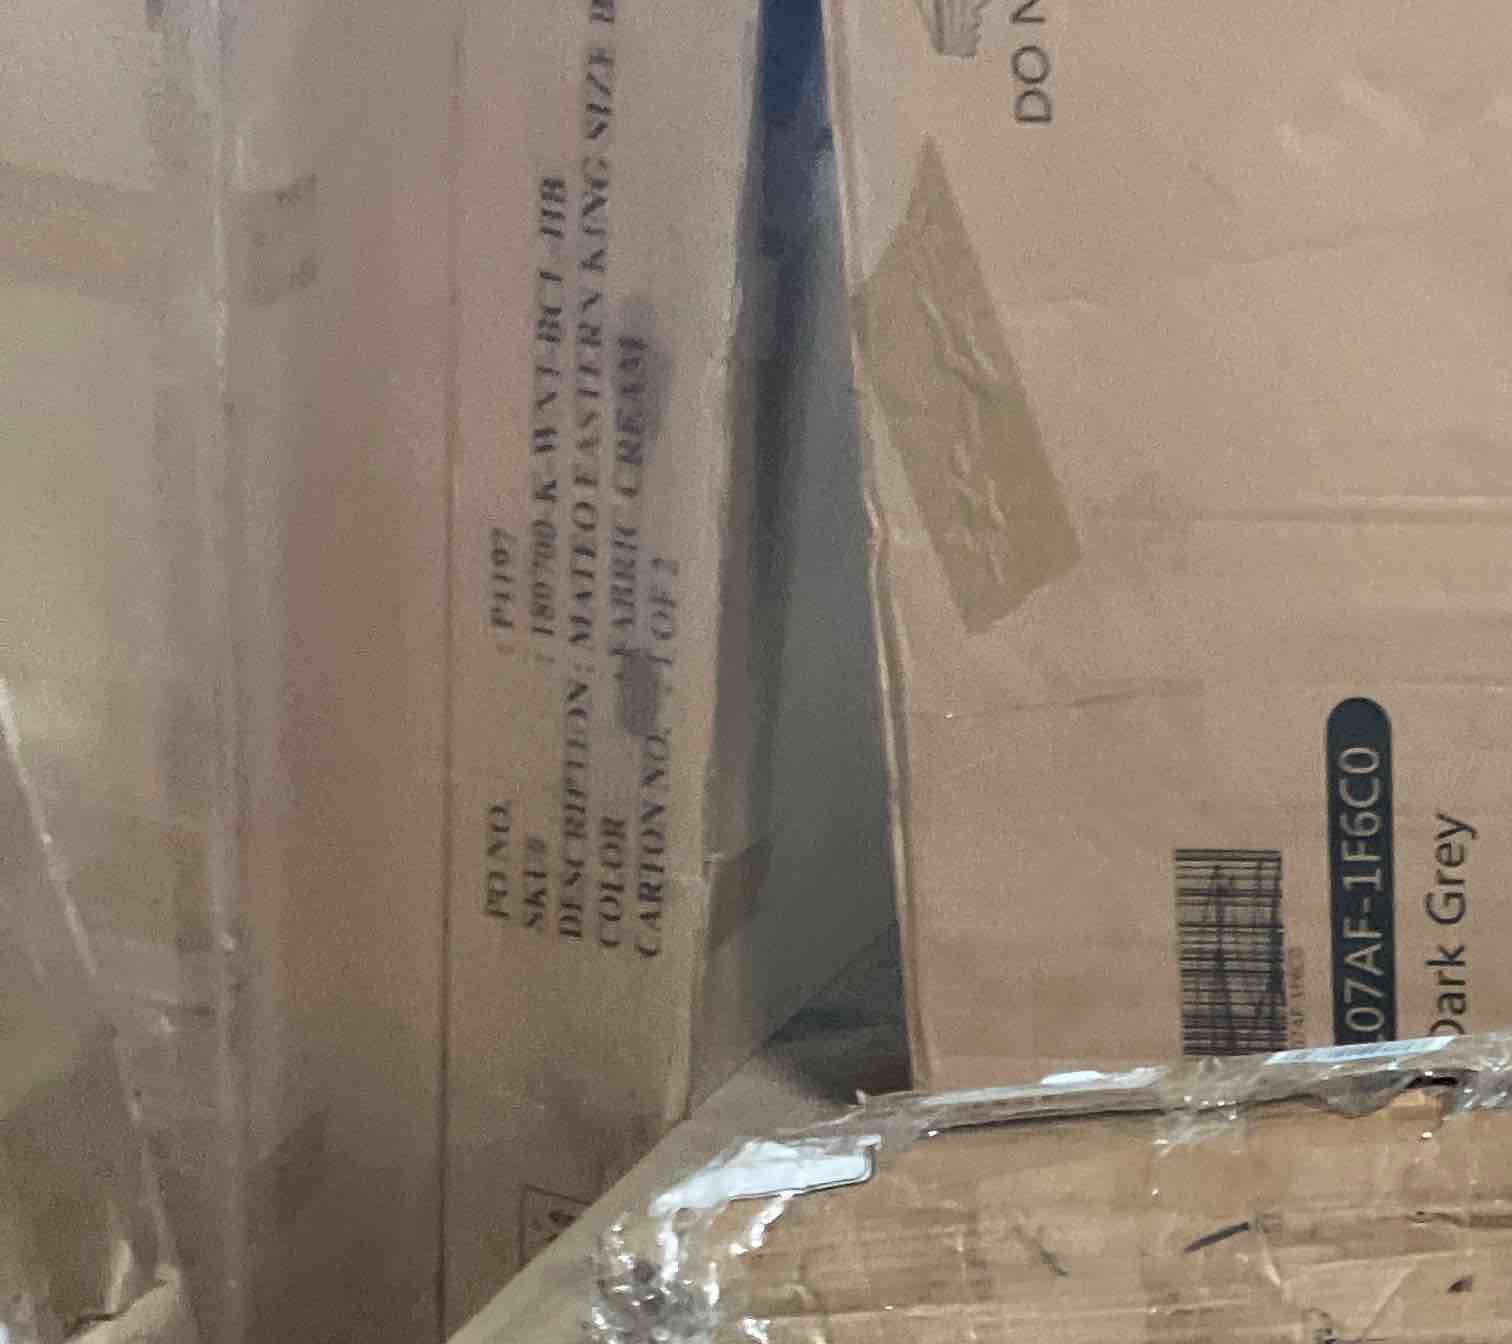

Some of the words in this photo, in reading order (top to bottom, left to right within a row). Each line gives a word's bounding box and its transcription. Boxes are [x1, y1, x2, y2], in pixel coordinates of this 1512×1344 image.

[584, 46, 614, 141] SIZE
[1011, 46, 1051, 123] DO
[579, 156, 608, 276] KING
[597, 816, 626, 949] COLOR
[1339, 747, 1386, 1042] 07AF-1F6C0
[1422, 812, 1478, 925] Grey
